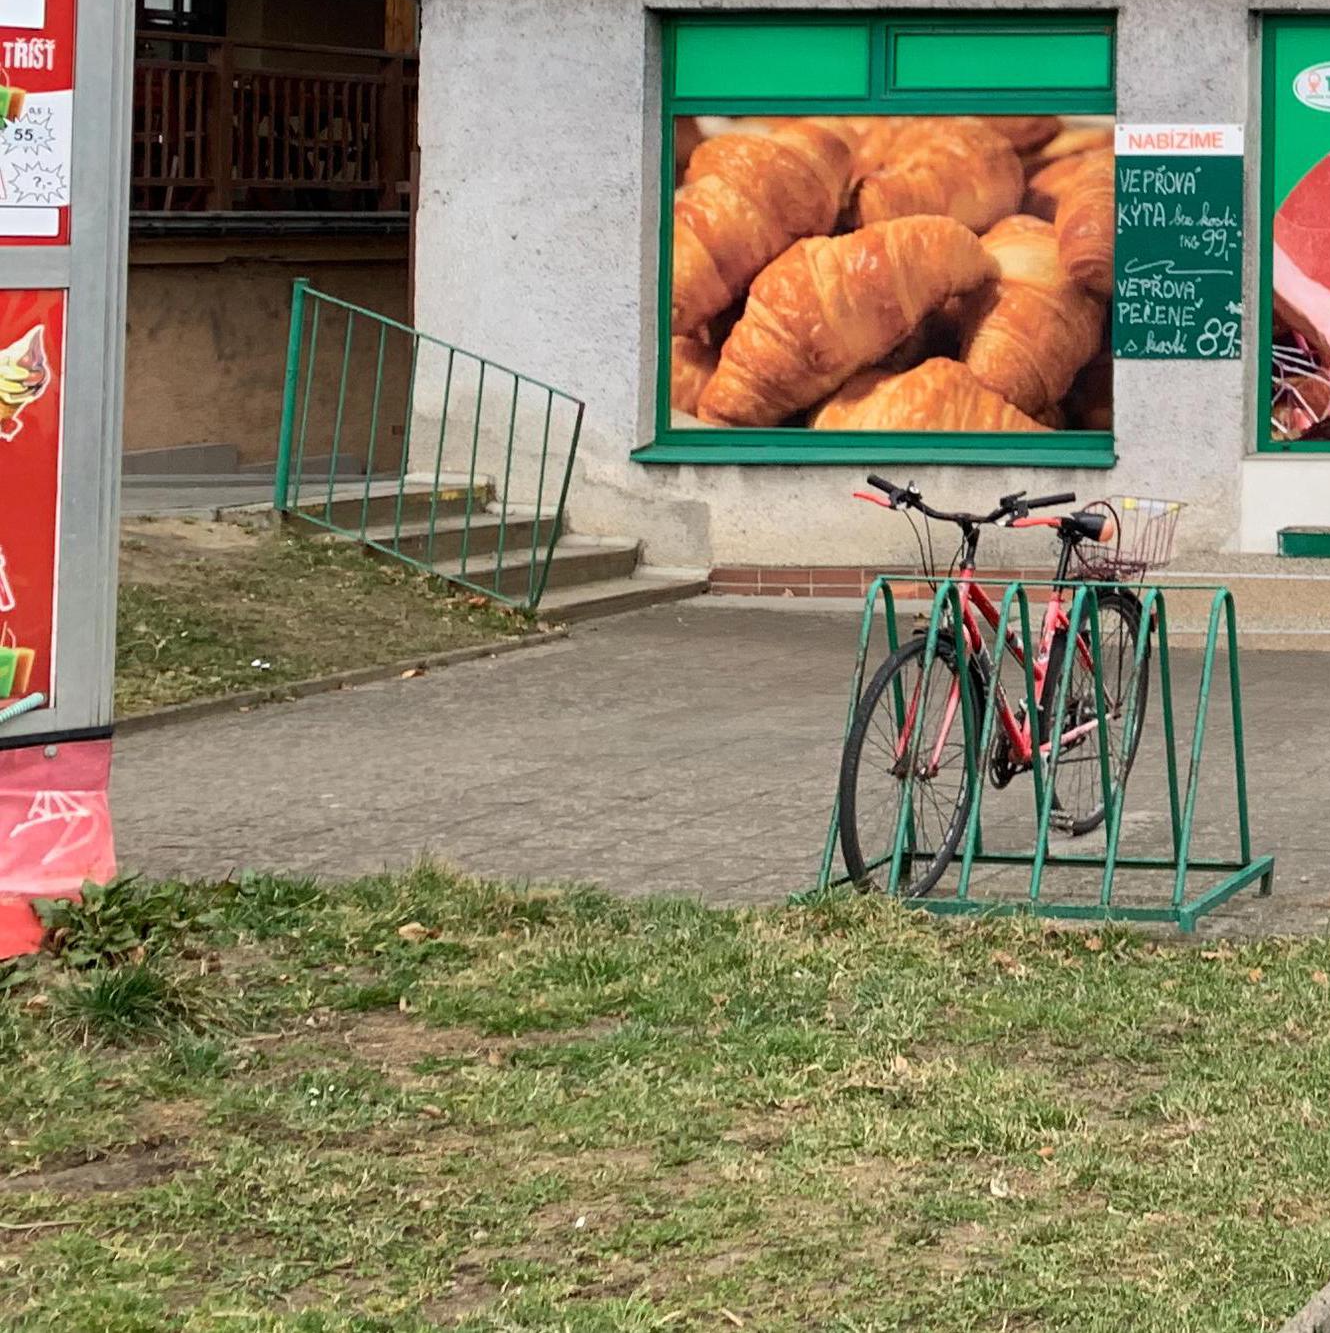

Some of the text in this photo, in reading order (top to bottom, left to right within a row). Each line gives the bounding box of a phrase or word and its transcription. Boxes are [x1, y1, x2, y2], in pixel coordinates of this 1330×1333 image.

[3, 37, 55, 71] TŘÍŠŤ
[14, 128, 44, 144] 55,-
[1128, 130, 1224, 149] NABÍZÍME
[1120, 165, 1201, 195] VEPŘOVÁ
[1118, 196, 1165, 227] KÝTA
[1202, 229, 1237, 261] 99,-
[1117, 273, 1201, 299] VEPŘOVÁ
[1124, 339, 1138, 352] s
